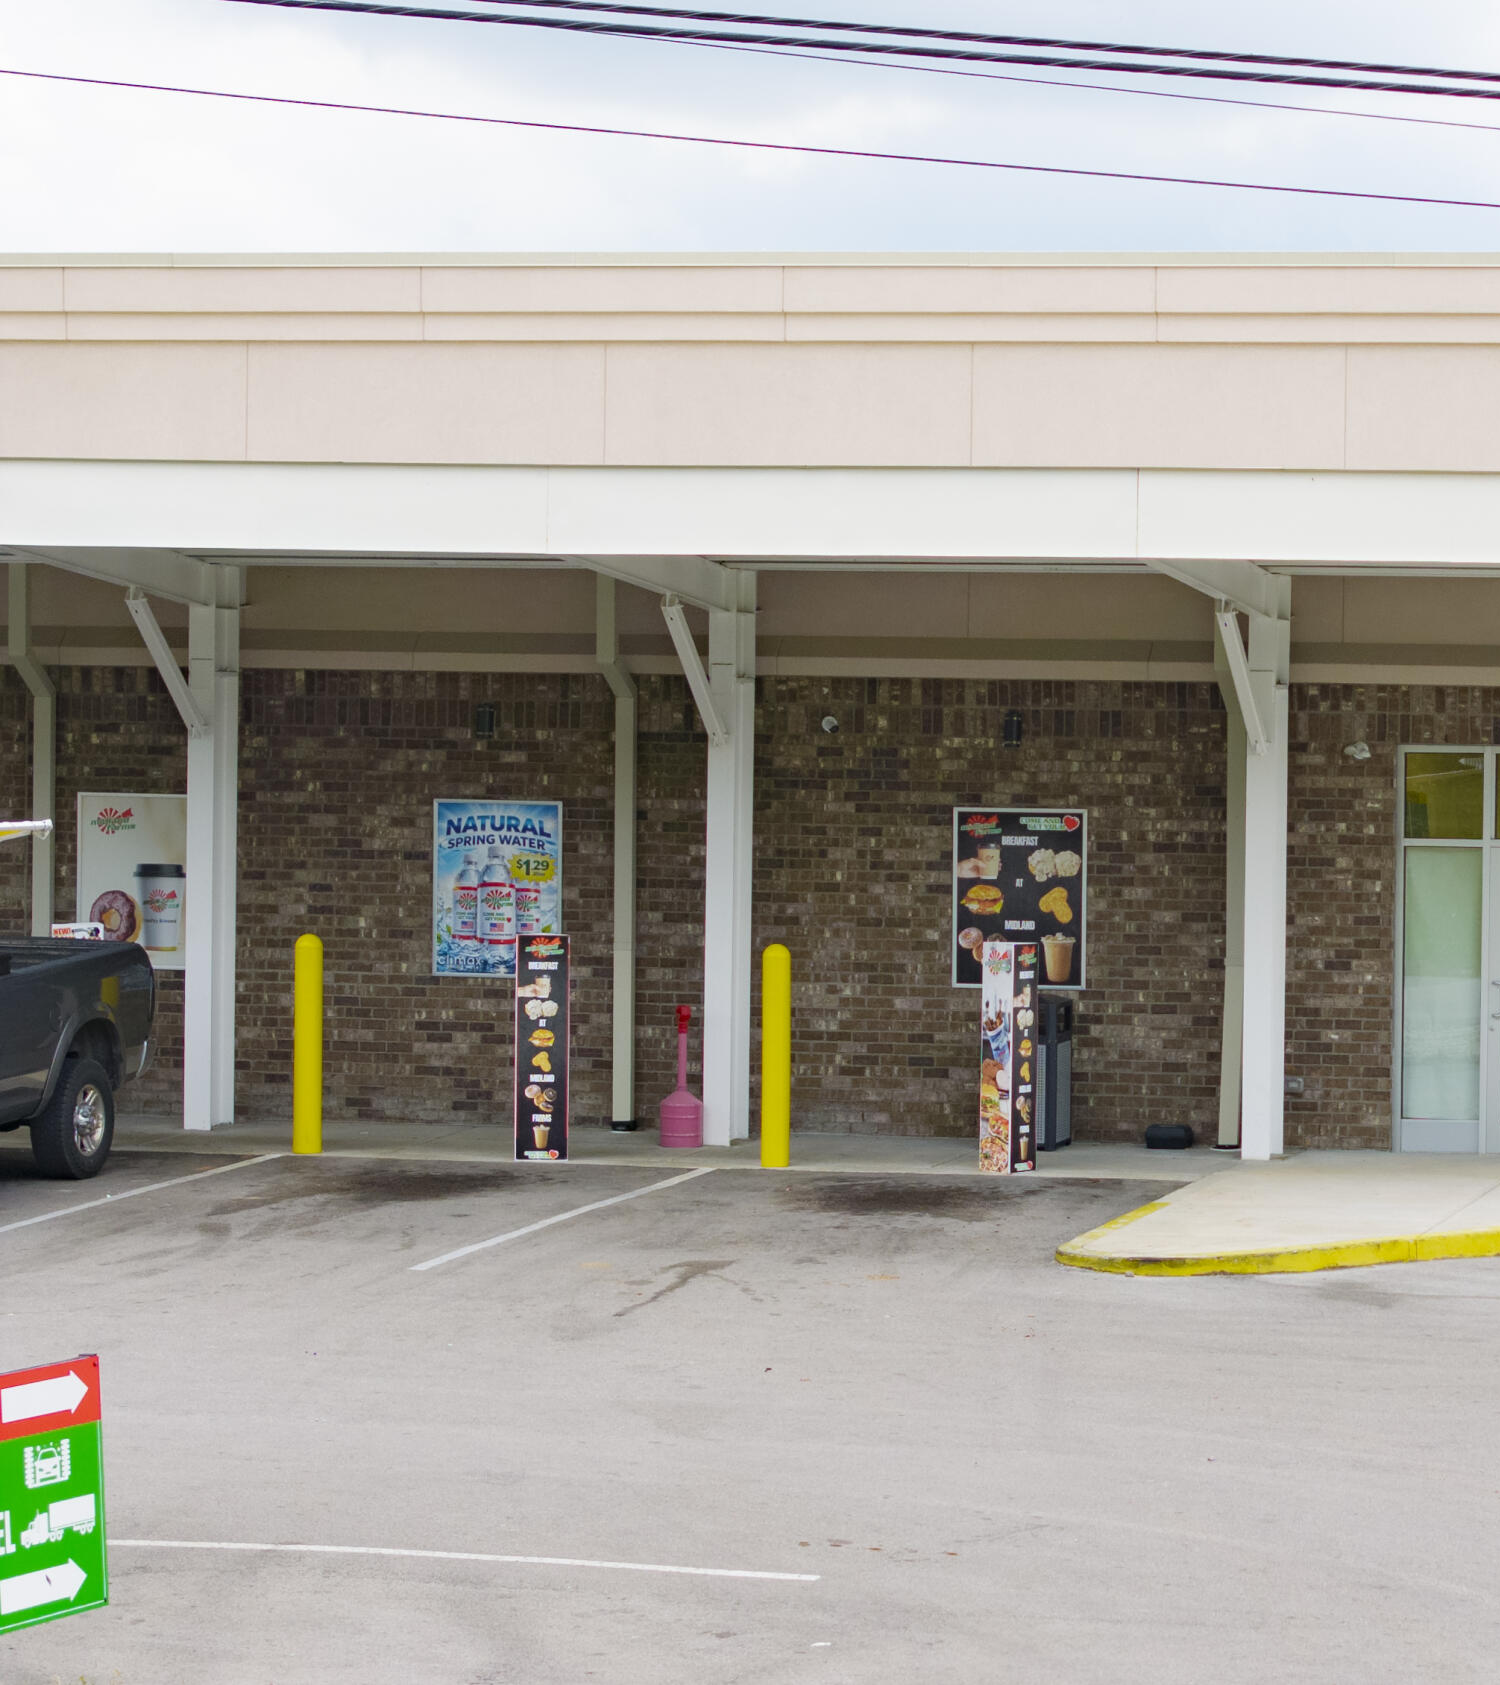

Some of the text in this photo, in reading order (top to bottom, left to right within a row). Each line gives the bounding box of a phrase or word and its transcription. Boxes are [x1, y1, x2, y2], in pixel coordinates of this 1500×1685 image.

[446, 815, 552, 838] NATURAL
[447, 834, 546, 851] SPRING WATER
[1001, 836, 1039, 846] BREAKFAST
[1015, 878, 1024, 888] AT
[1004, 920, 1035, 931] MIDLAND
